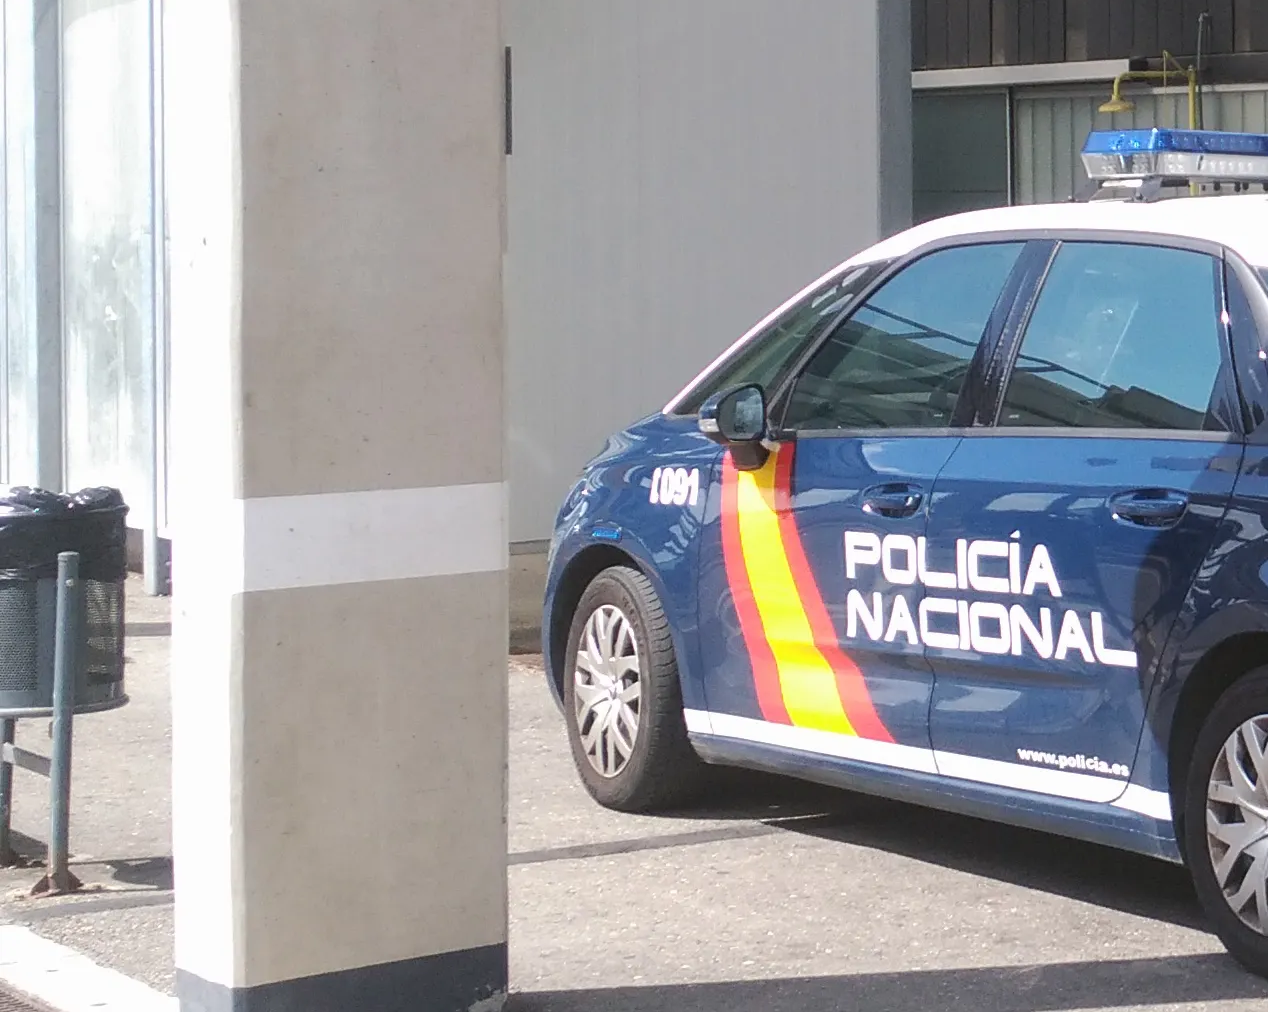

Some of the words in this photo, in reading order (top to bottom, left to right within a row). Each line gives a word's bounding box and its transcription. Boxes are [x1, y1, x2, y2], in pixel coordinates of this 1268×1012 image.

[650, 467, 700, 507] 1091
[844, 530, 1063, 598] POLICÍA
[845, 588, 1138, 668] NACIONAL
[1017, 745, 1131, 778] www.policia.es
